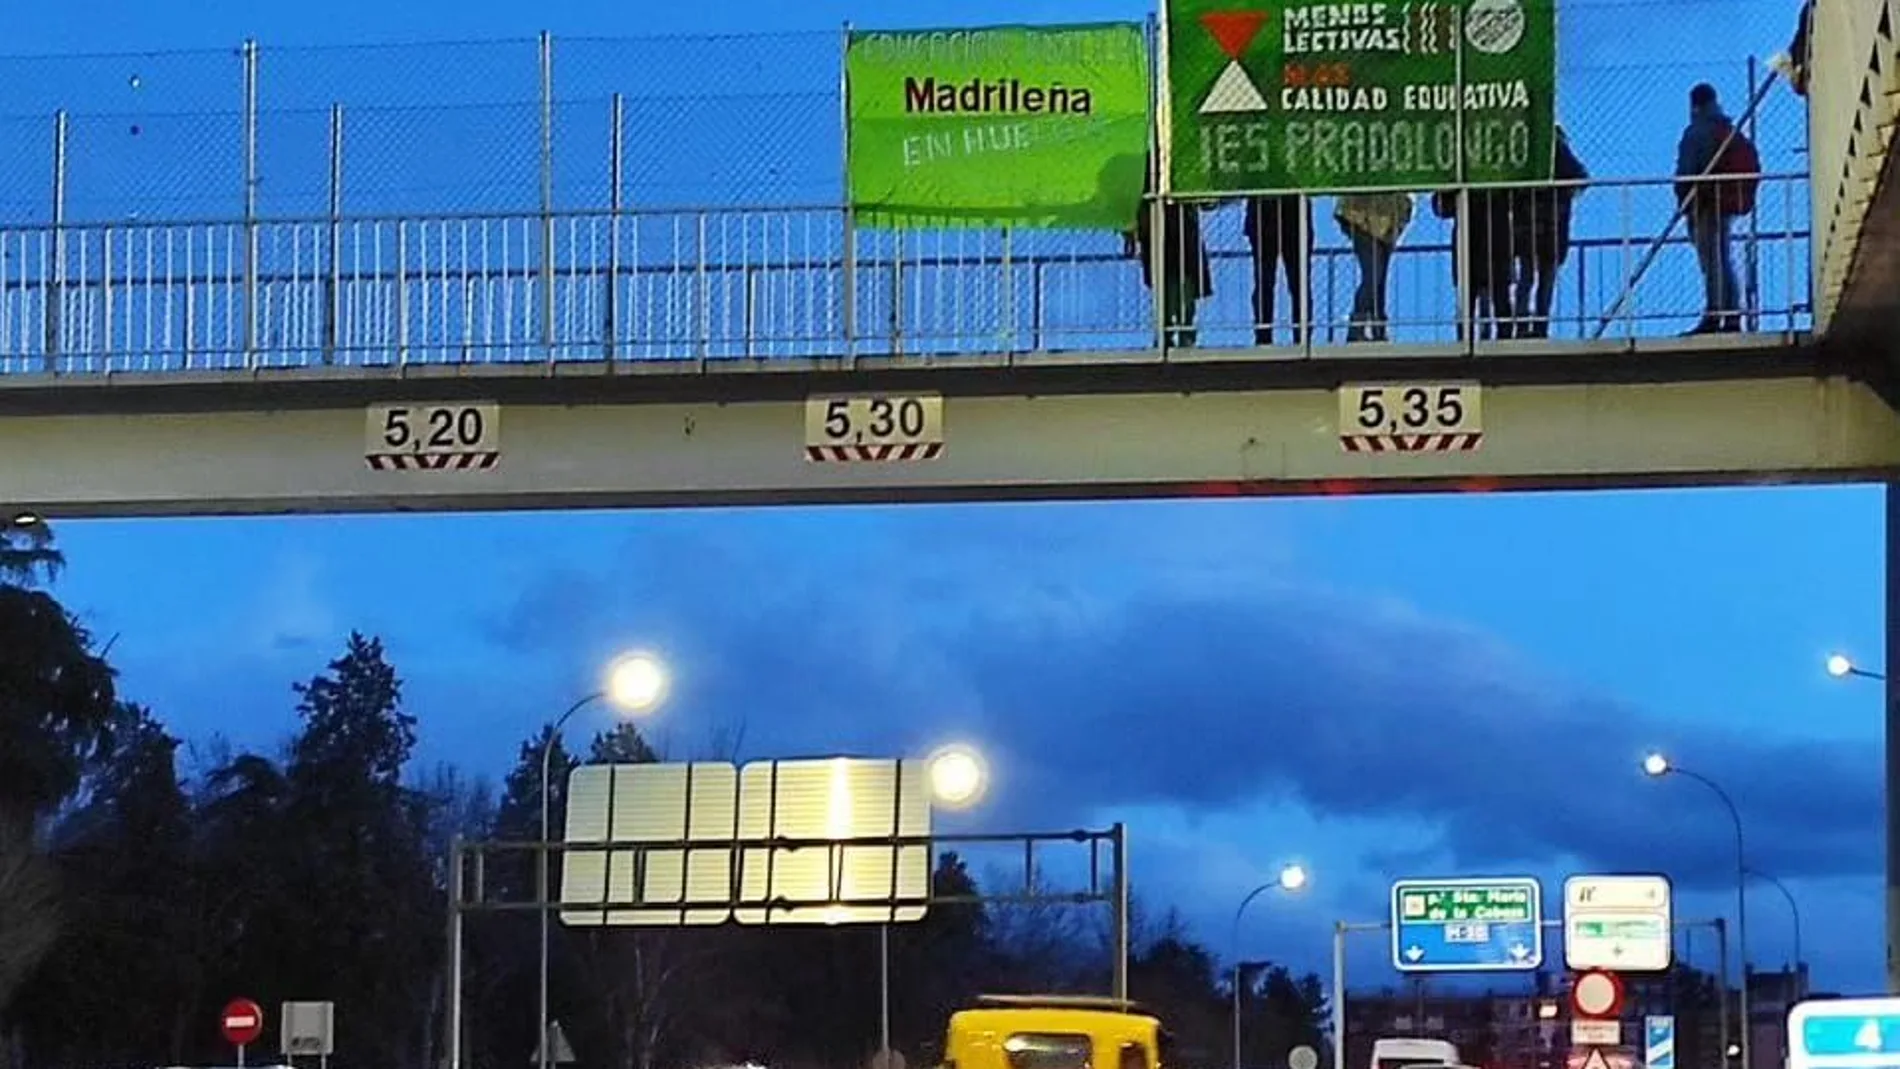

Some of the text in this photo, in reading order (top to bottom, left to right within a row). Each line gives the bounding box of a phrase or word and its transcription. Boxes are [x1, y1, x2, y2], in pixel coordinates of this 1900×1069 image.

[1283, 3, 1387, 30] MENOS
[1284, 28, 1400, 53] LECTIVAS
[905, 76, 1092, 114] Madrileña
[1281, 86, 1388, 111] CALIDAD
[903, 131, 952, 167] EN
[1200, 121, 1270, 174] IES
[825, 400, 924, 442] 5,30
[1358, 388, 1462, 432] 5,35
[384, 408, 483, 451] 5,20
